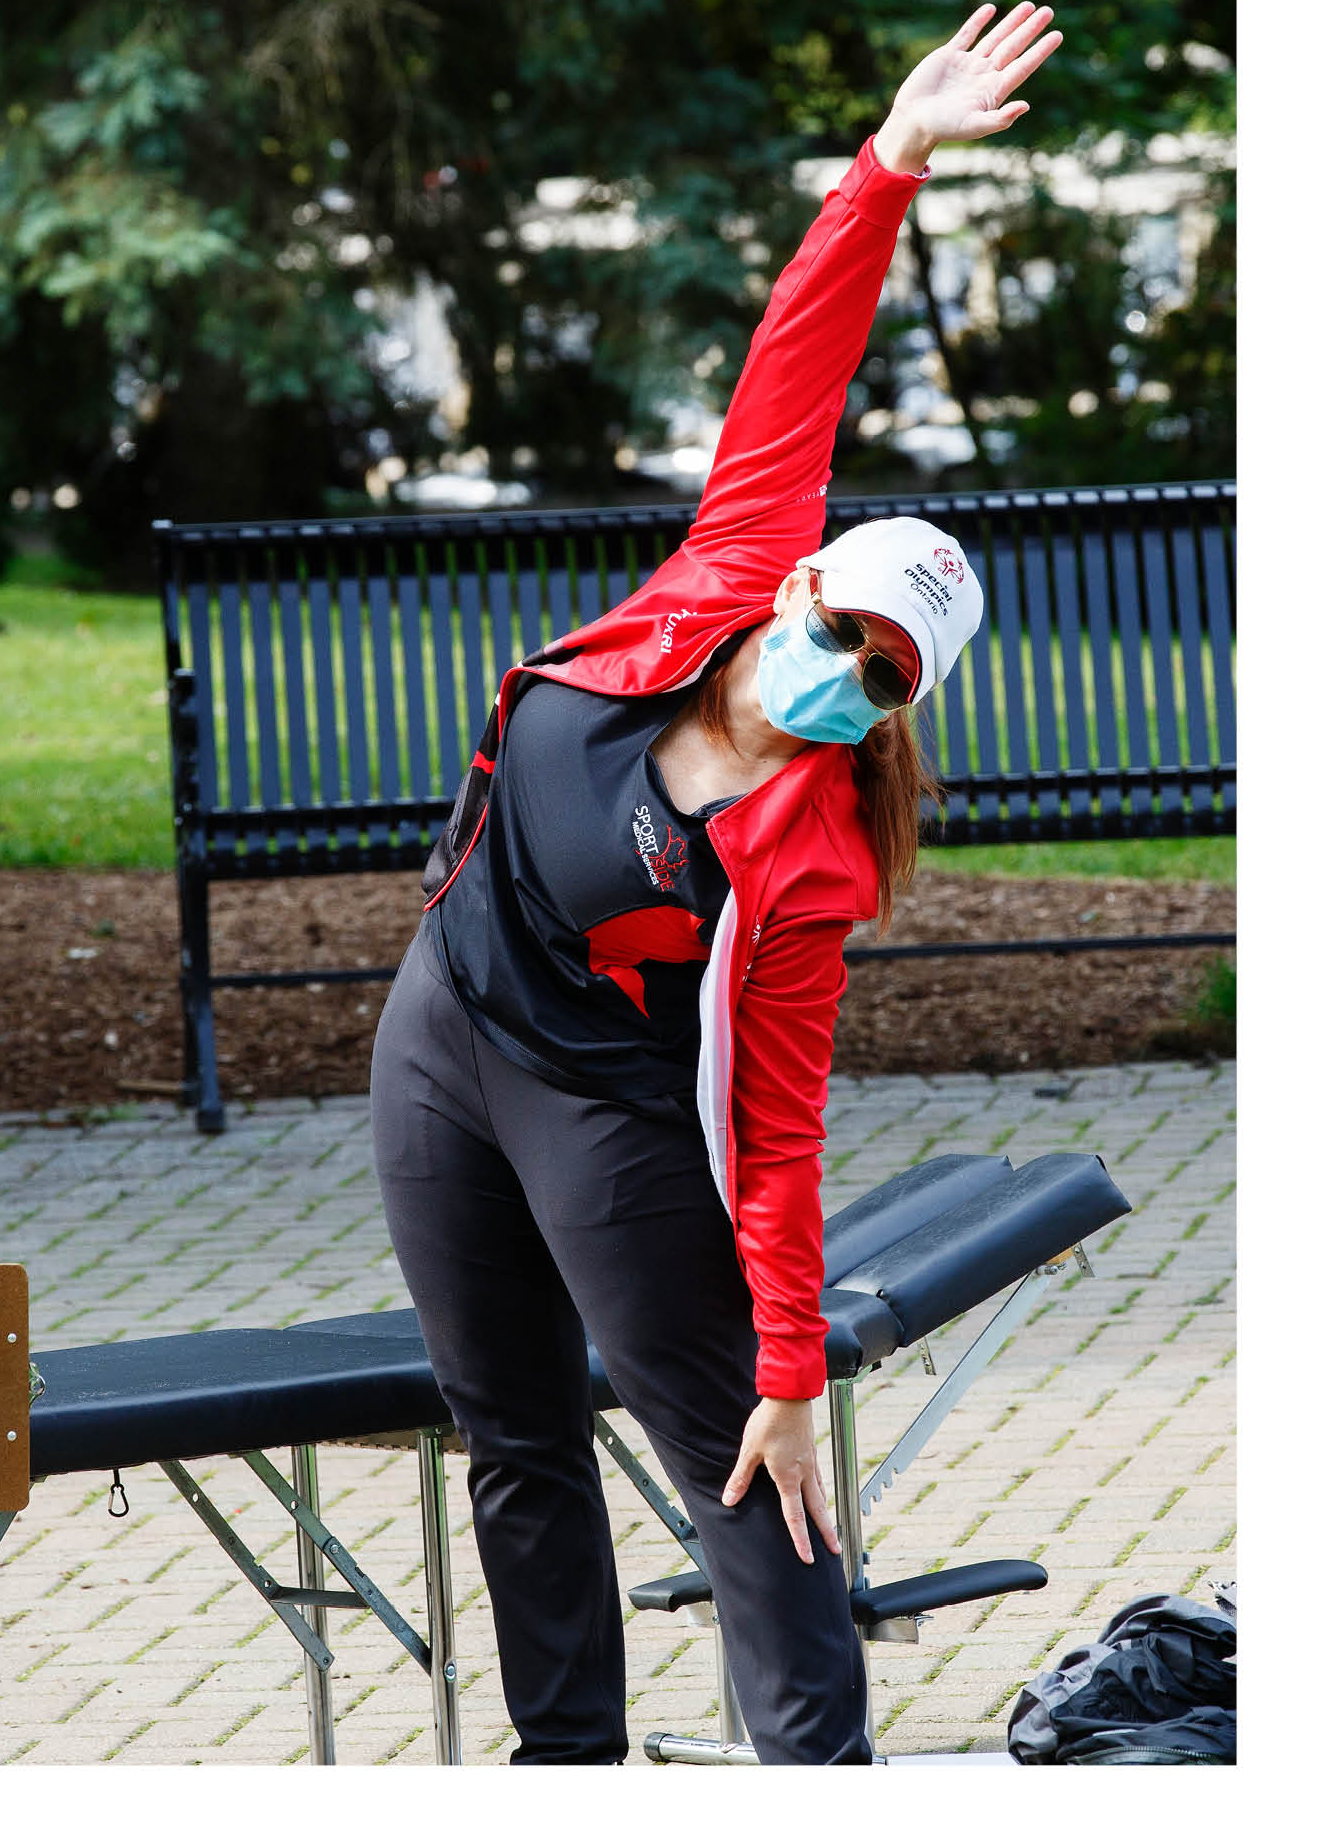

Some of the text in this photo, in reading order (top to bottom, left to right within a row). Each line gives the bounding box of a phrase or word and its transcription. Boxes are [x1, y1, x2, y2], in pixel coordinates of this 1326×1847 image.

[904, 568, 948, 616] Olympics
[910, 583, 938, 614] Ontario
[914, 563, 953, 602] Special
[632, 821, 659, 885] MEDICAL SERVICES
[635, 805, 659, 854] SPORT
